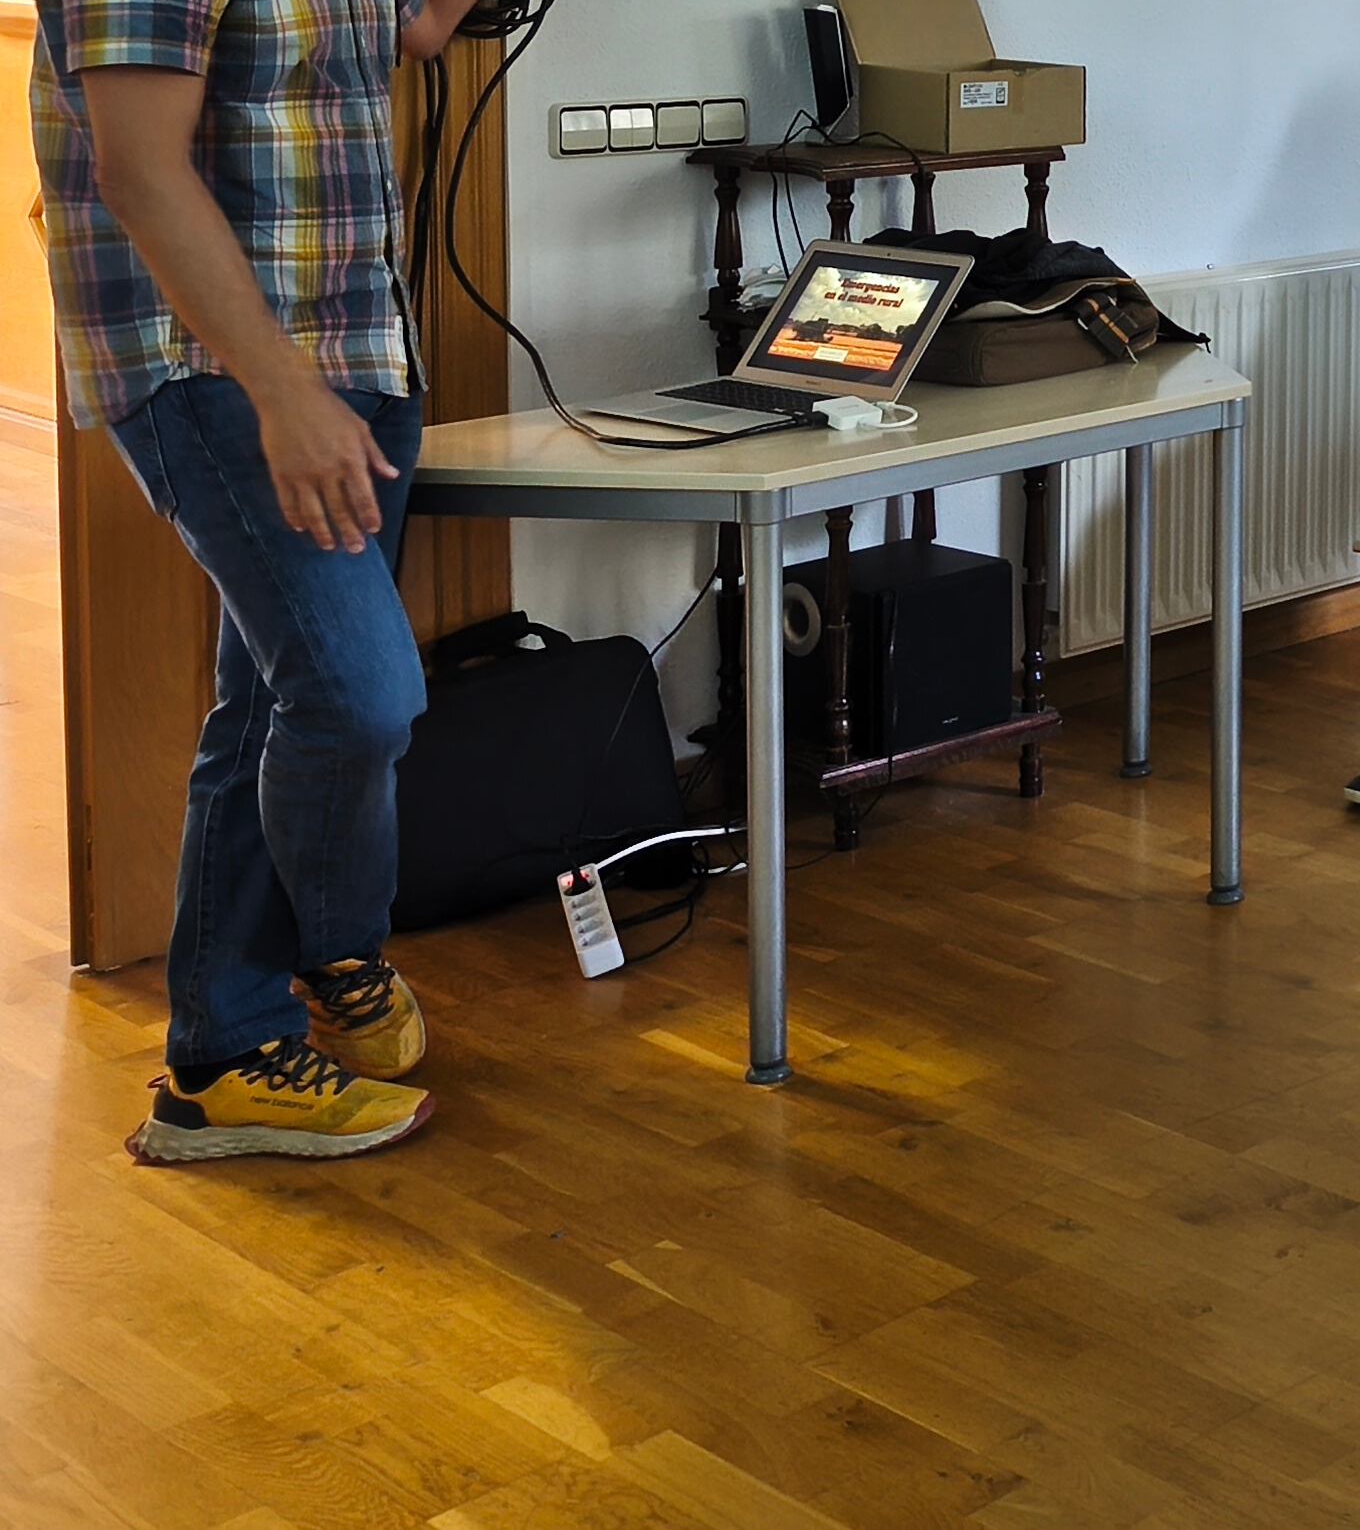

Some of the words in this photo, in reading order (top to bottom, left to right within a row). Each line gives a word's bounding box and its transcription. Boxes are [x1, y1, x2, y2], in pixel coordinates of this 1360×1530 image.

[841, 278, 900, 294] Emergencias
[824, 291, 837, 300] en
[837, 291, 849, 301] el
[847, 294, 877, 305] medio
[877, 298, 904, 308] rural
[249, 1095, 271, 1104] new
[271, 1097, 315, 1111] balance
